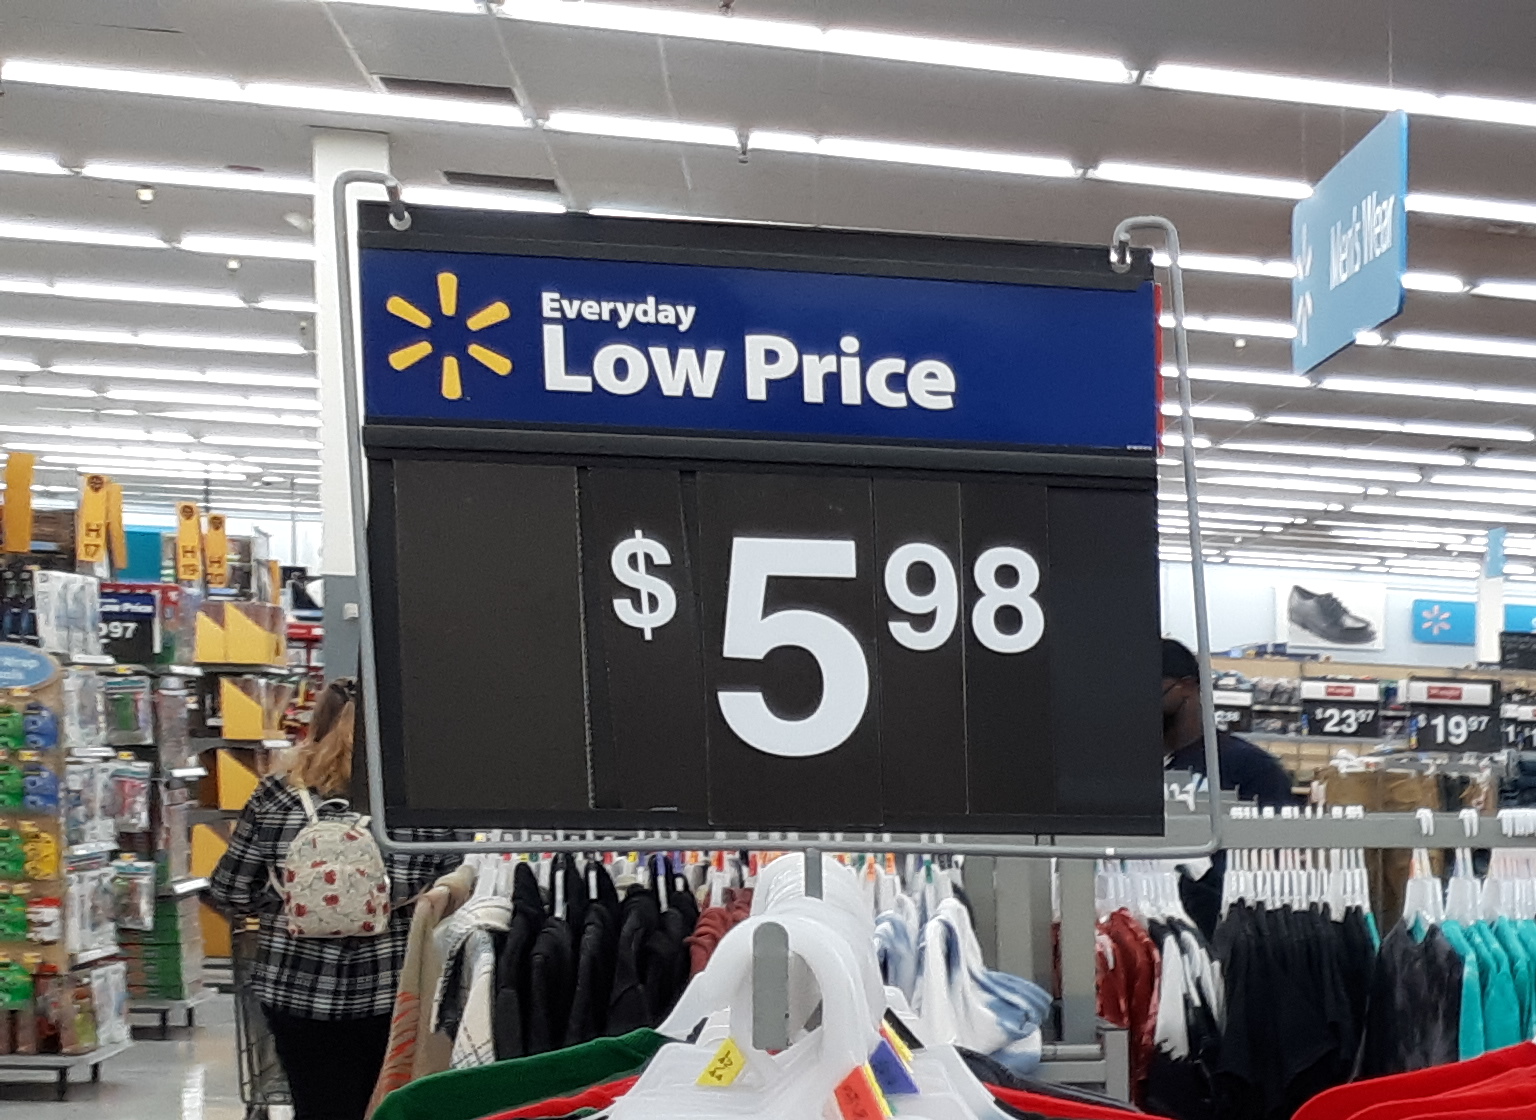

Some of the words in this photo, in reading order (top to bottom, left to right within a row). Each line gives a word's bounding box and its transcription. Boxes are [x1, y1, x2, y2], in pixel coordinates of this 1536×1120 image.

[1329, 205, 1361, 291] Men's
[1361, 191, 1395, 265] Wear
[541, 291, 696, 331] Everyday
[542, 324, 724, 399] Low
[745, 336, 957, 411] Price
